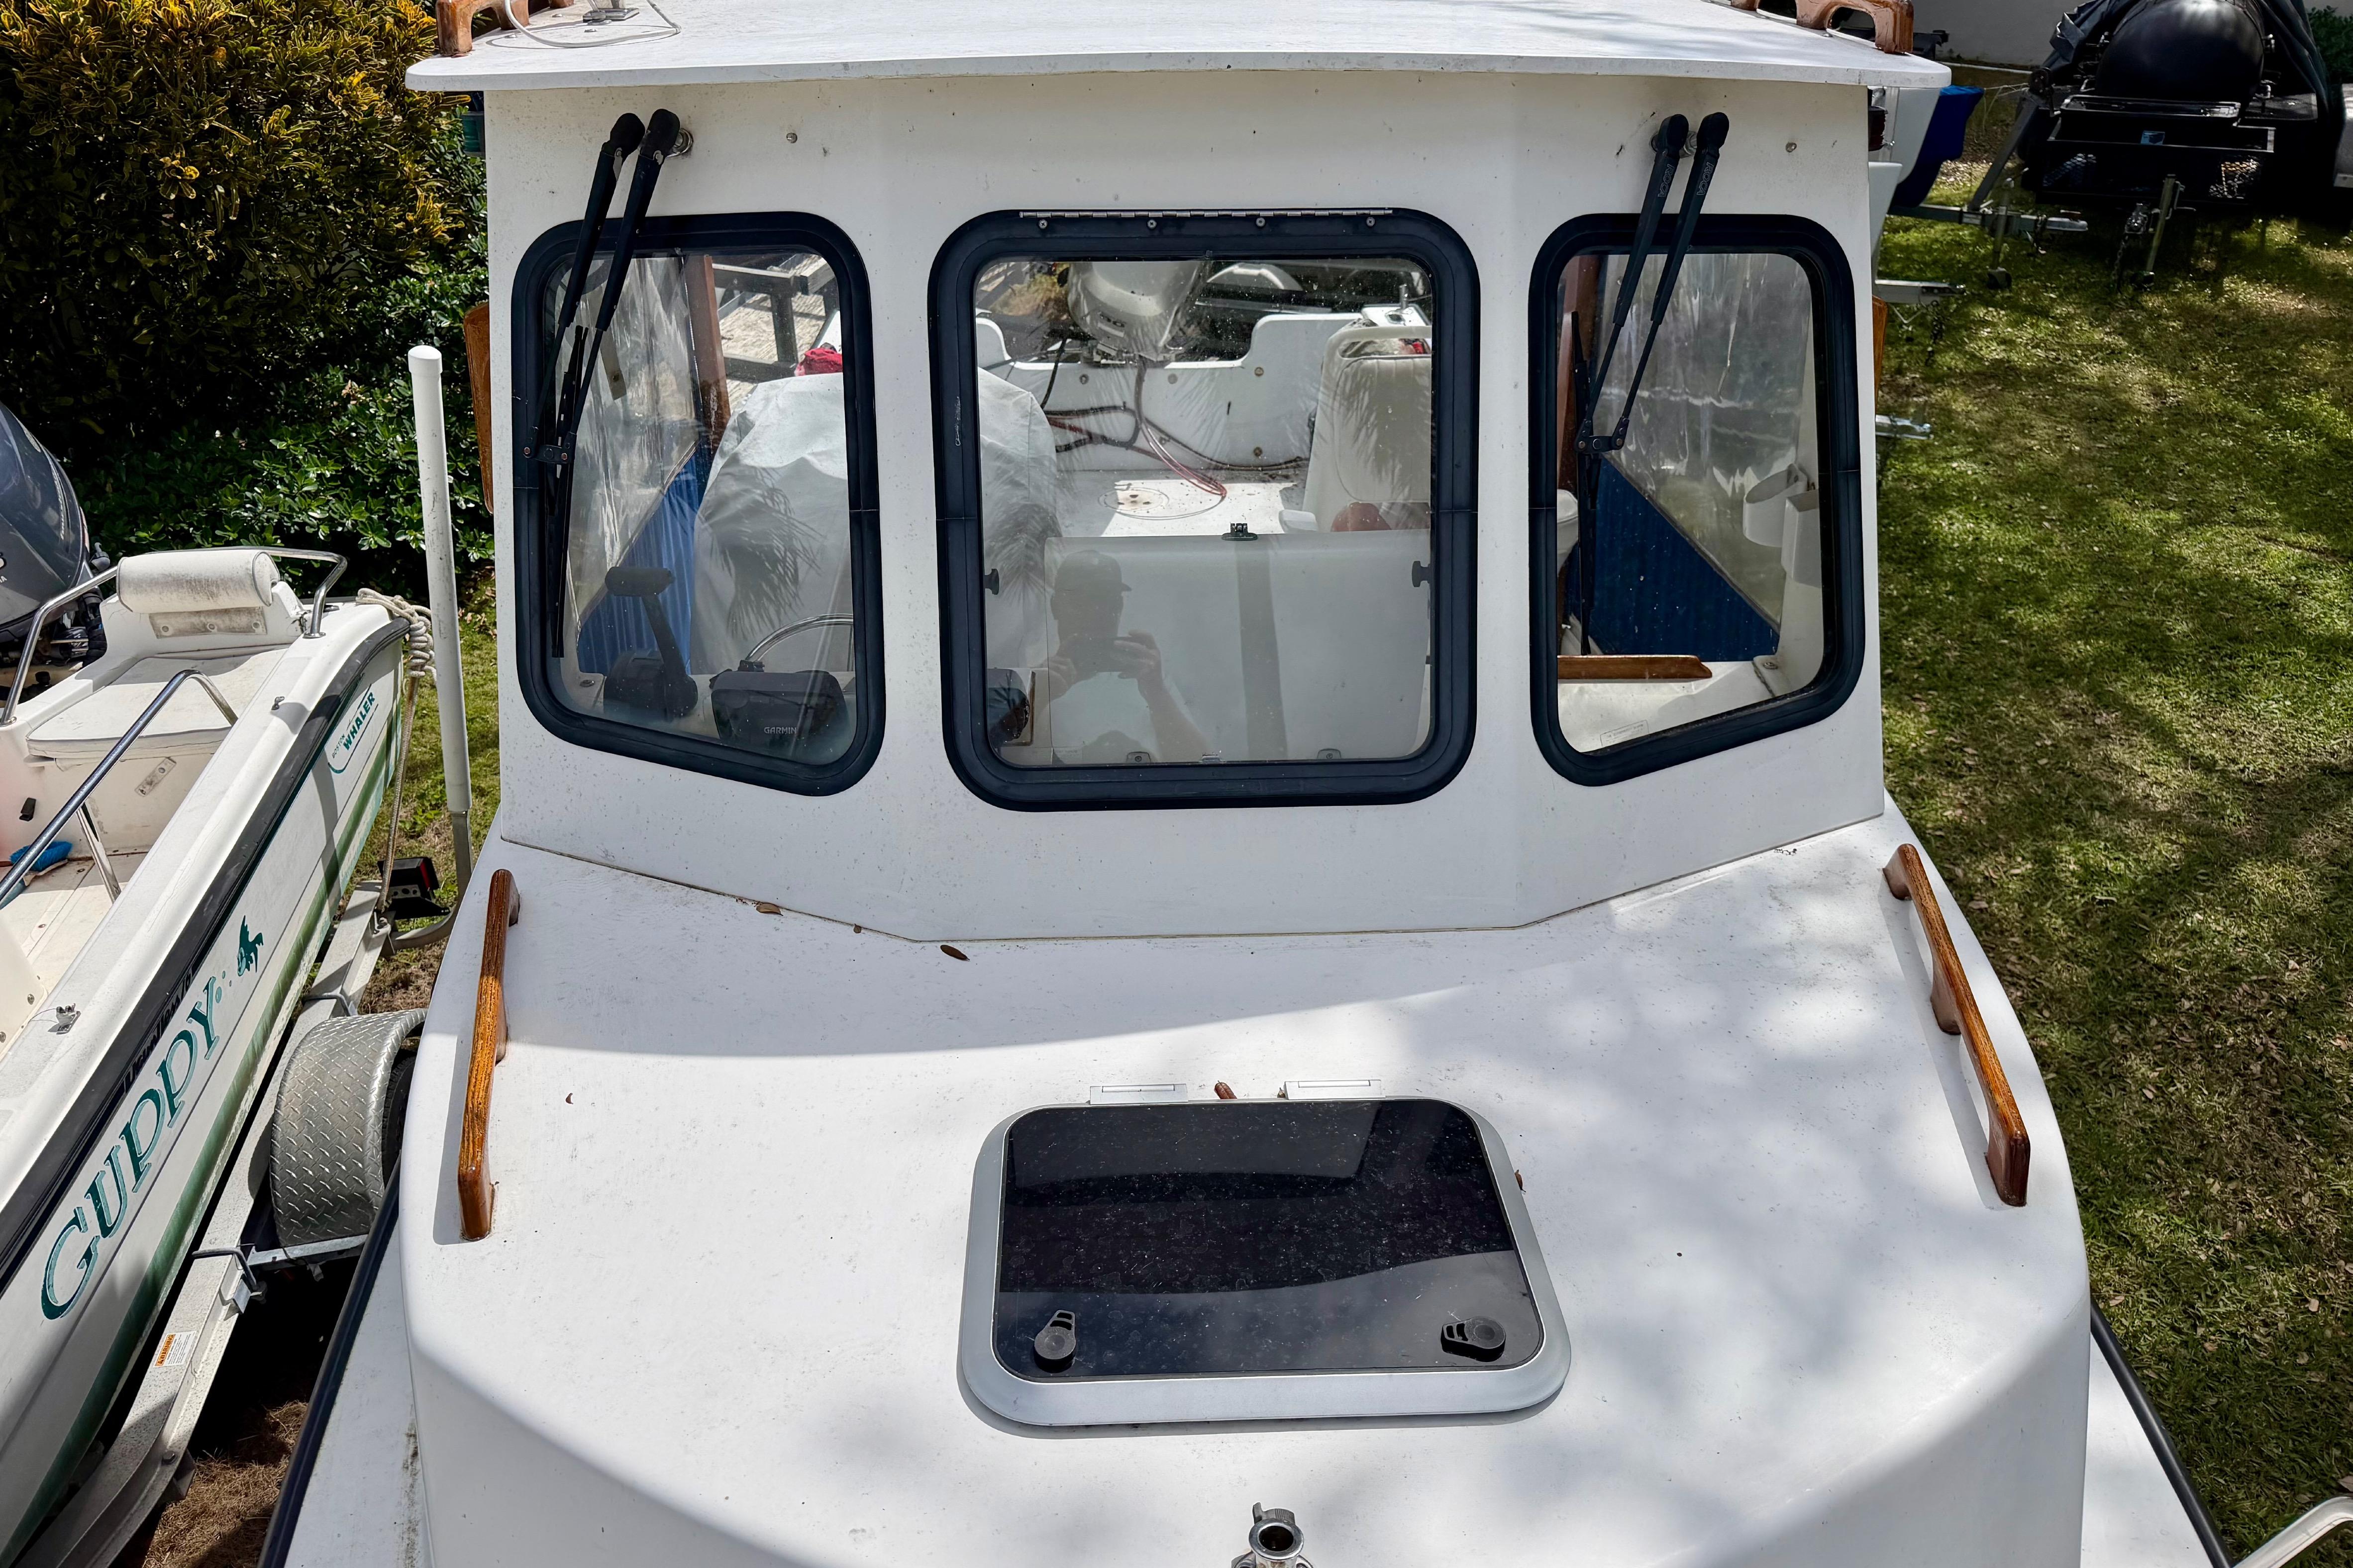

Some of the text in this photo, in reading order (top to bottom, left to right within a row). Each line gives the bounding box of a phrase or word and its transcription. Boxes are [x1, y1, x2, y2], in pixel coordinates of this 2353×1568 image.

[342, 692, 375, 751] WHALER
[331, 734, 345, 759] BOSTON
[41, 976, 220, 1320] GUPPY
[159, 1334, 174, 1361] WARNING
